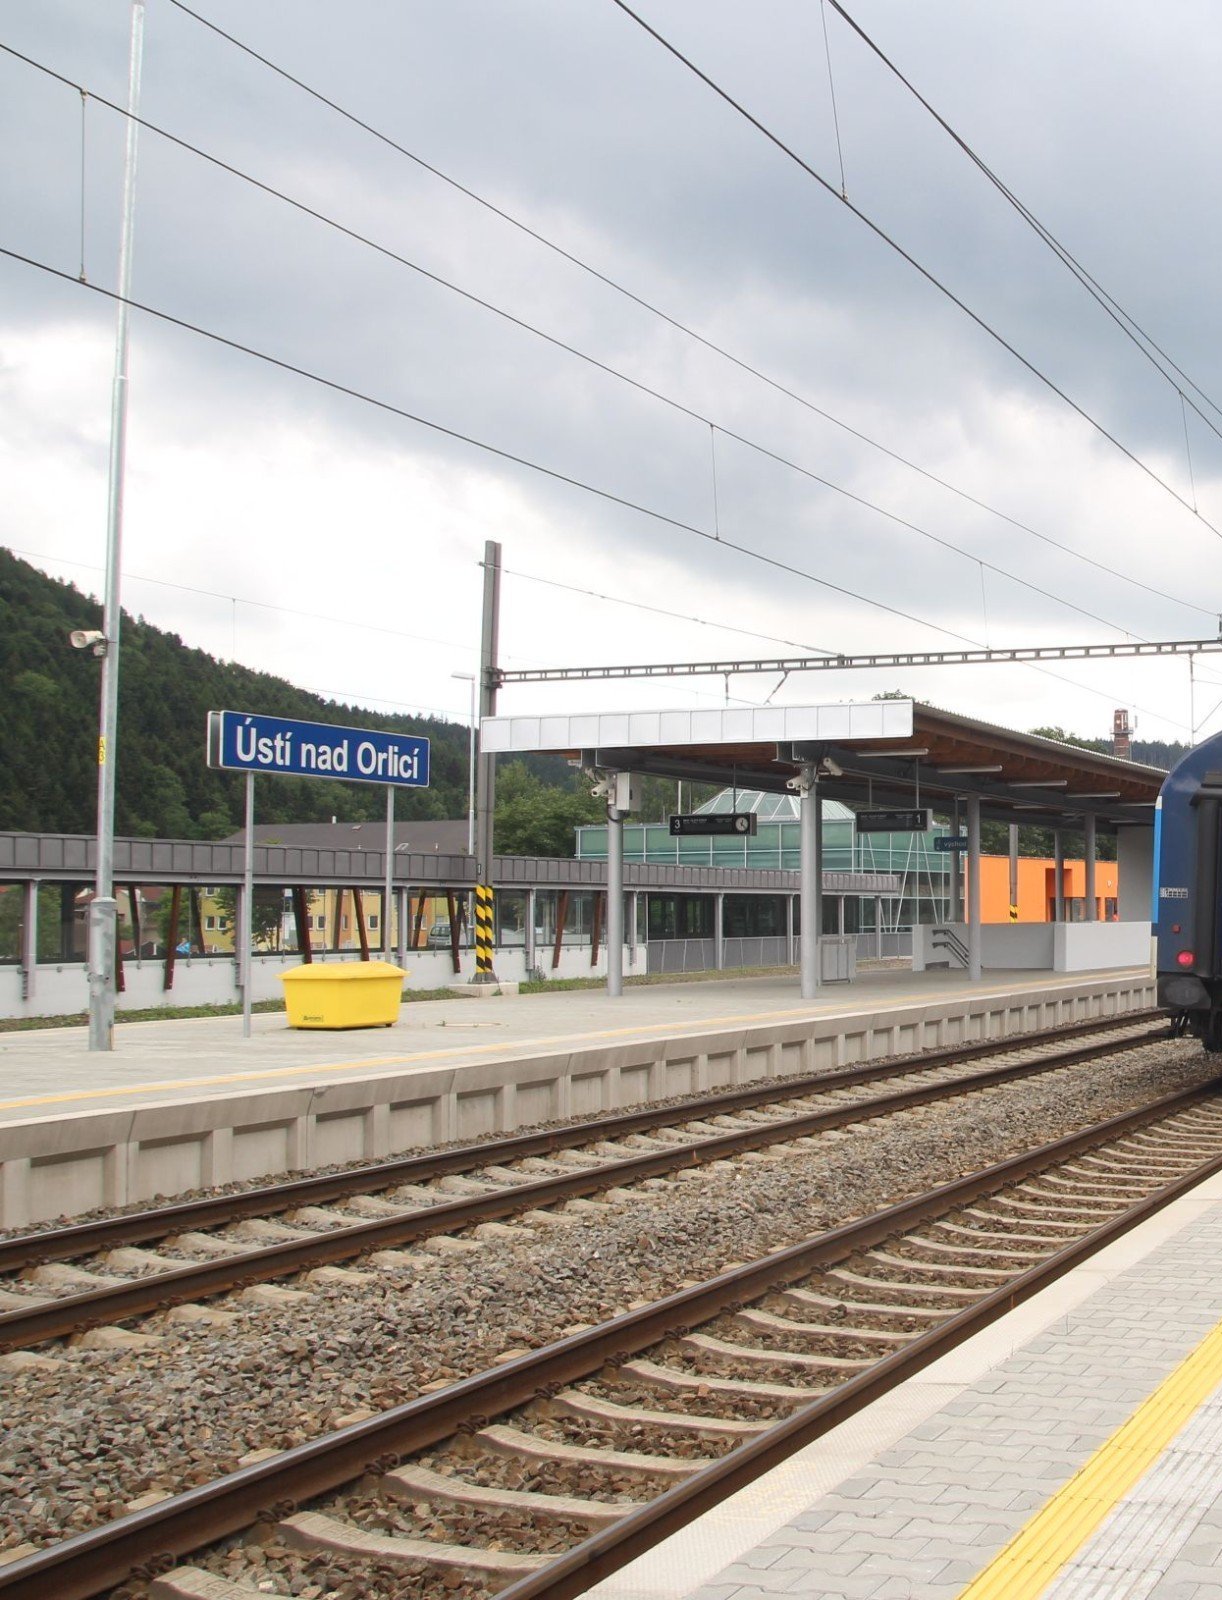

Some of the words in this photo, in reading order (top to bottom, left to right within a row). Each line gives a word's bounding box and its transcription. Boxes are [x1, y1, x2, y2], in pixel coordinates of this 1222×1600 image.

[237, 718, 292, 766] Ústí
[301, 740, 348, 772] nad
[357, 741, 419, 779] Orlicí
[674, 819, 681, 829] 3
[916, 813, 921, 824] 1
